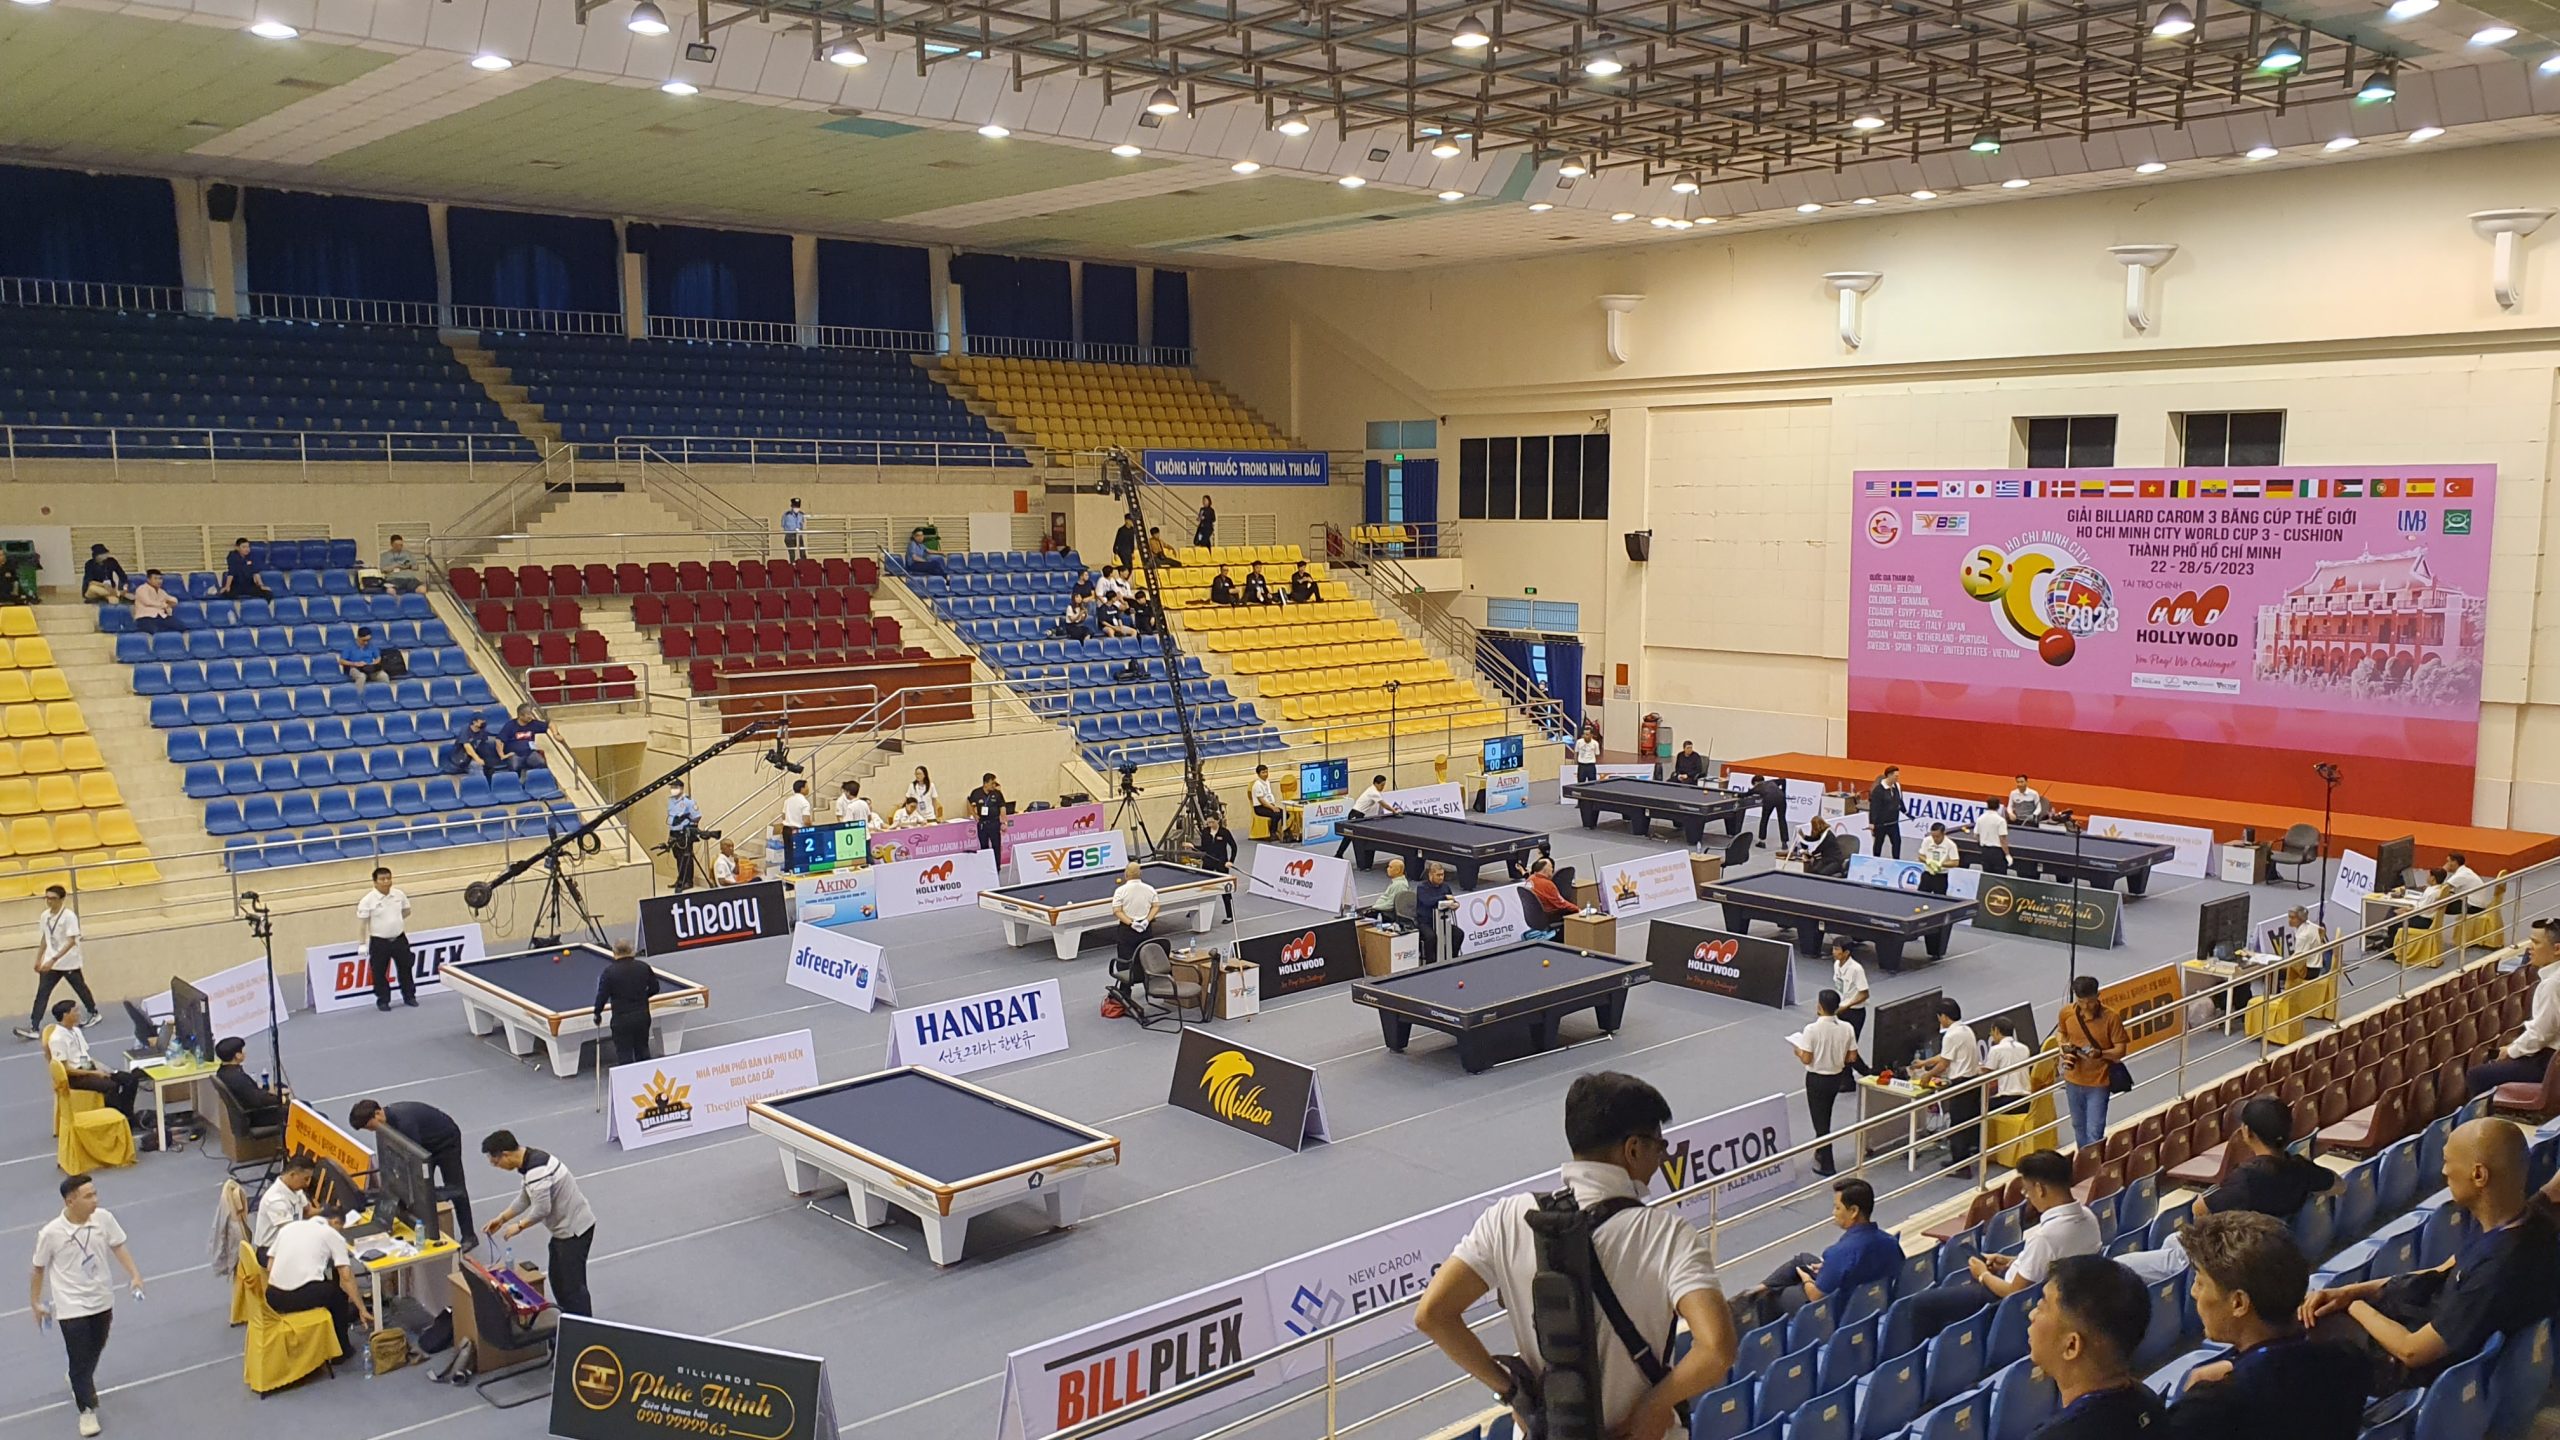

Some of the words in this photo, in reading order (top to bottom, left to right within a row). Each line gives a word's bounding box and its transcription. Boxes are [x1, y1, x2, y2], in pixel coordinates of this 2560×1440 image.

[1155, 457, 1187, 476] KHÔNG
[1189, 457, 1206, 476] HÚT
[1208, 456, 1238, 476] THUỐC
[1240, 462, 1268, 477] TRONG
[1270, 459, 1287, 476] NHÀ
[1289, 463, 1302, 476] THI
[1304, 457, 1320, 477] ĐẤU
[2067, 506, 2092, 523] GIẢI
[2095, 509, 2153, 523] BILLIARD
[2157, 509, 2204, 524] CAROM
[2208, 510, 2217, 524] 3
[2221, 507, 2259, 525] BĂNG
[2263, 507, 2291, 525] CÚP
[2295, 506, 2326, 525] THẾ
[2327, 507, 2357, 526] GIỚI
[2076, 526, 2092, 539] HO
[2095, 527, 2115, 539] CHI
[2118, 527, 2150, 540] MINH
[2154, 527, 2179, 540] CITY
[2182, 527, 2229, 541] WORLD
[2232, 528, 2258, 541] CUP
[2262, 528, 2270, 542] 3
[2283, 528, 2343, 542] CUSHION
[2005, 538, 2020, 552] HO
[2022, 530, 2039, 543] CHI
[2042, 530, 2069, 549] MINH
[2068, 542, 2092, 563] CITY
[2129, 543, 2169, 558] THÀNH
[2172, 541, 2198, 558] PHỐ
[2221, 543, 2243, 559] CHÍ
[2246, 546, 2281, 560] MINH
[2151, 560, 2167, 574] 22
[2179, 561, 2254, 576] 28/5/2023
[1869, 584, 1892, 593] AUSTRIA
[1898, 608, 1916, 617] EGYPT
[1921, 609, 1943, 618] FRANCE
[2068, 606, 2119, 633] 2023
[1900, 620, 1920, 629] GREECE
[1925, 621, 1942, 630] ITALY
[1946, 622, 1966, 631] JAPAN
[1958, 634, 1989, 644] PORTUGAL
[2136, 629, 2238, 647] HOLLYWOOD
[1965, 647, 1988, 657] STATES
[1993, 648, 2020, 658] VIETNAM
[1334, 769, 1340, 780] 0
[1316, 804, 1344, 817] AKINO
[805, 838, 815, 852] 2
[845, 834, 853, 846] 0
[815, 878, 857, 894] AKINO
[916, 882, 961, 895] HOLLYWOOD
[1279, 876, 1313, 889] HOLLYWOOD
[671, 897, 762, 939] theory
[1469, 923, 1514, 941] classone
[1279, 957, 1325, 976] HOLLYWOOD
[1687, 959, 1740, 979] HOLLYWOOD
[915, 990, 1042, 1046] HANBAT
[696, 1065, 710, 1080] NHÀ
[712, 1062, 731, 1078] PHÂN
[764, 1054, 774, 1068] VÀ
[747, 1072, 761, 1085] CAO
[1214, 1076, 1273, 1126] Million
[641, 1110, 688, 1129] BILLIARDS
[1660, 1126, 1778, 1208] VECTOR
[1031, 1173, 1040, 1187] 4
[1348, 1265, 1376, 1286] NEW
[1379, 1249, 1422, 1274] CAROM
[677, 1366, 751, 1386] BILLIARDS
[1057, 1312, 1243, 1431] BILLPLEX
[630, 1371, 694, 1403] Phúc
[701, 1383, 774, 1420] Thịnh
[636, 1408, 664, 1425] 090
